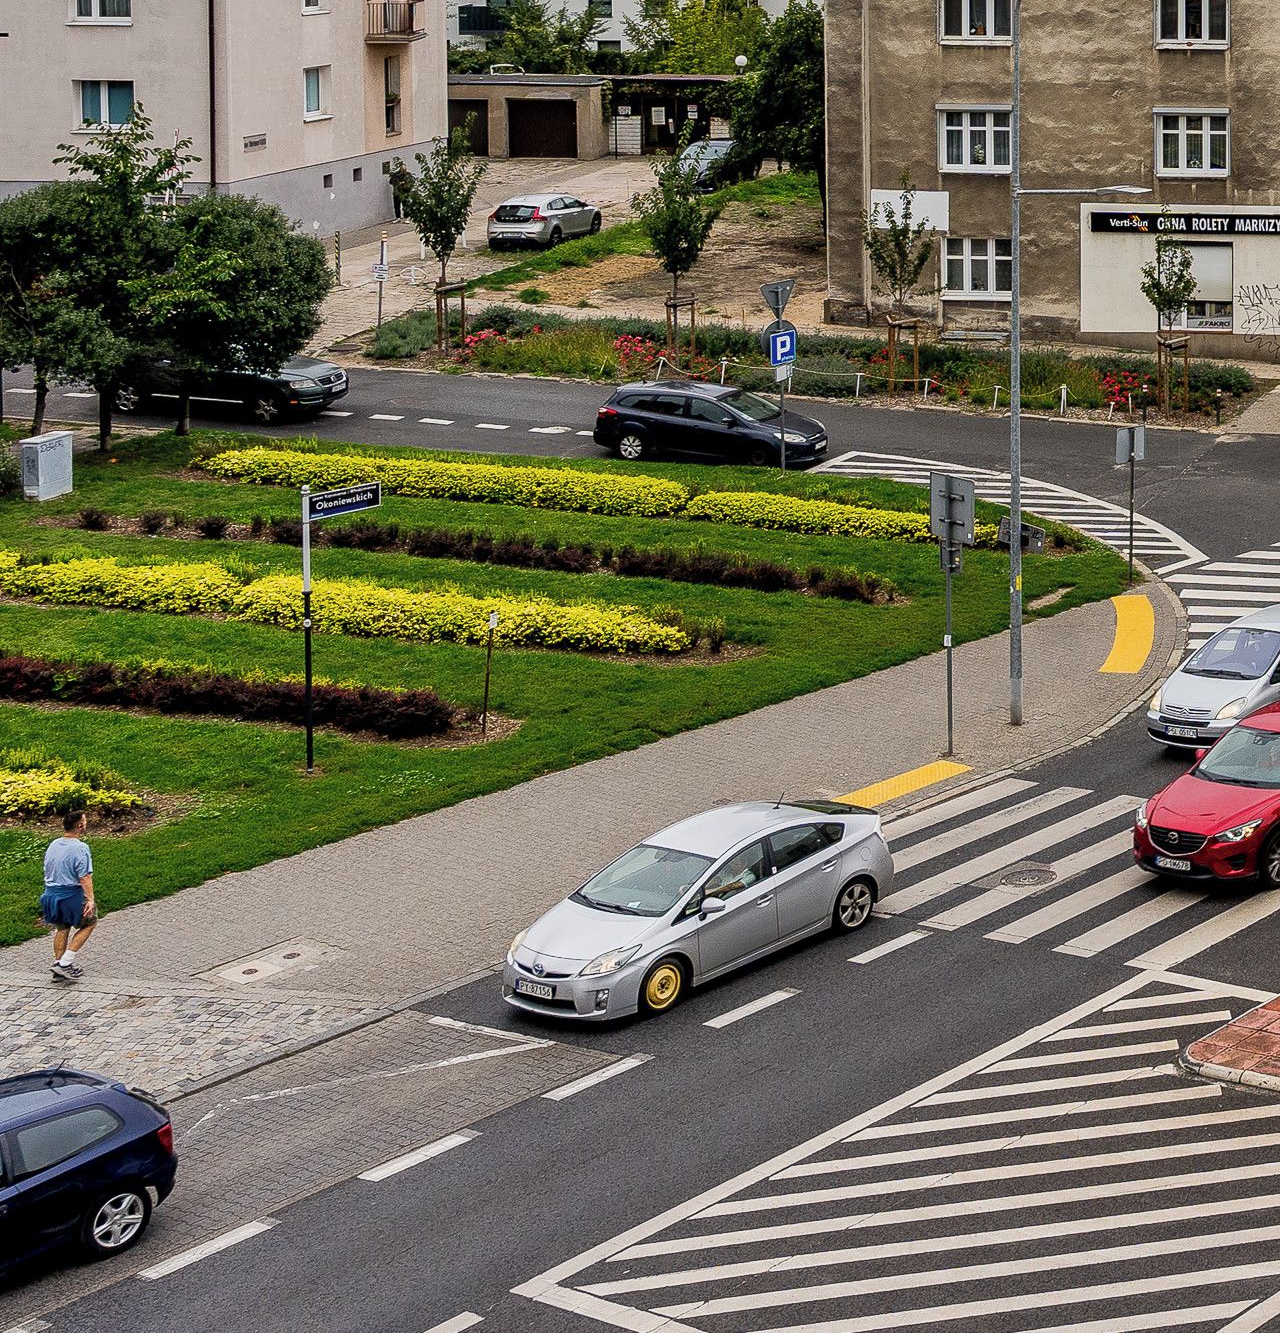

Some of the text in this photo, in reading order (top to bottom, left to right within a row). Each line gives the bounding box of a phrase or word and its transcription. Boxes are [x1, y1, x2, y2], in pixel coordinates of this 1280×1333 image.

[1109, 217, 1149, 227] Verti-Sun
[1191, 217, 1229, 231] ROLETY
[776, 335, 791, 361] P
[315, 491, 373, 510] Okoniewskich
